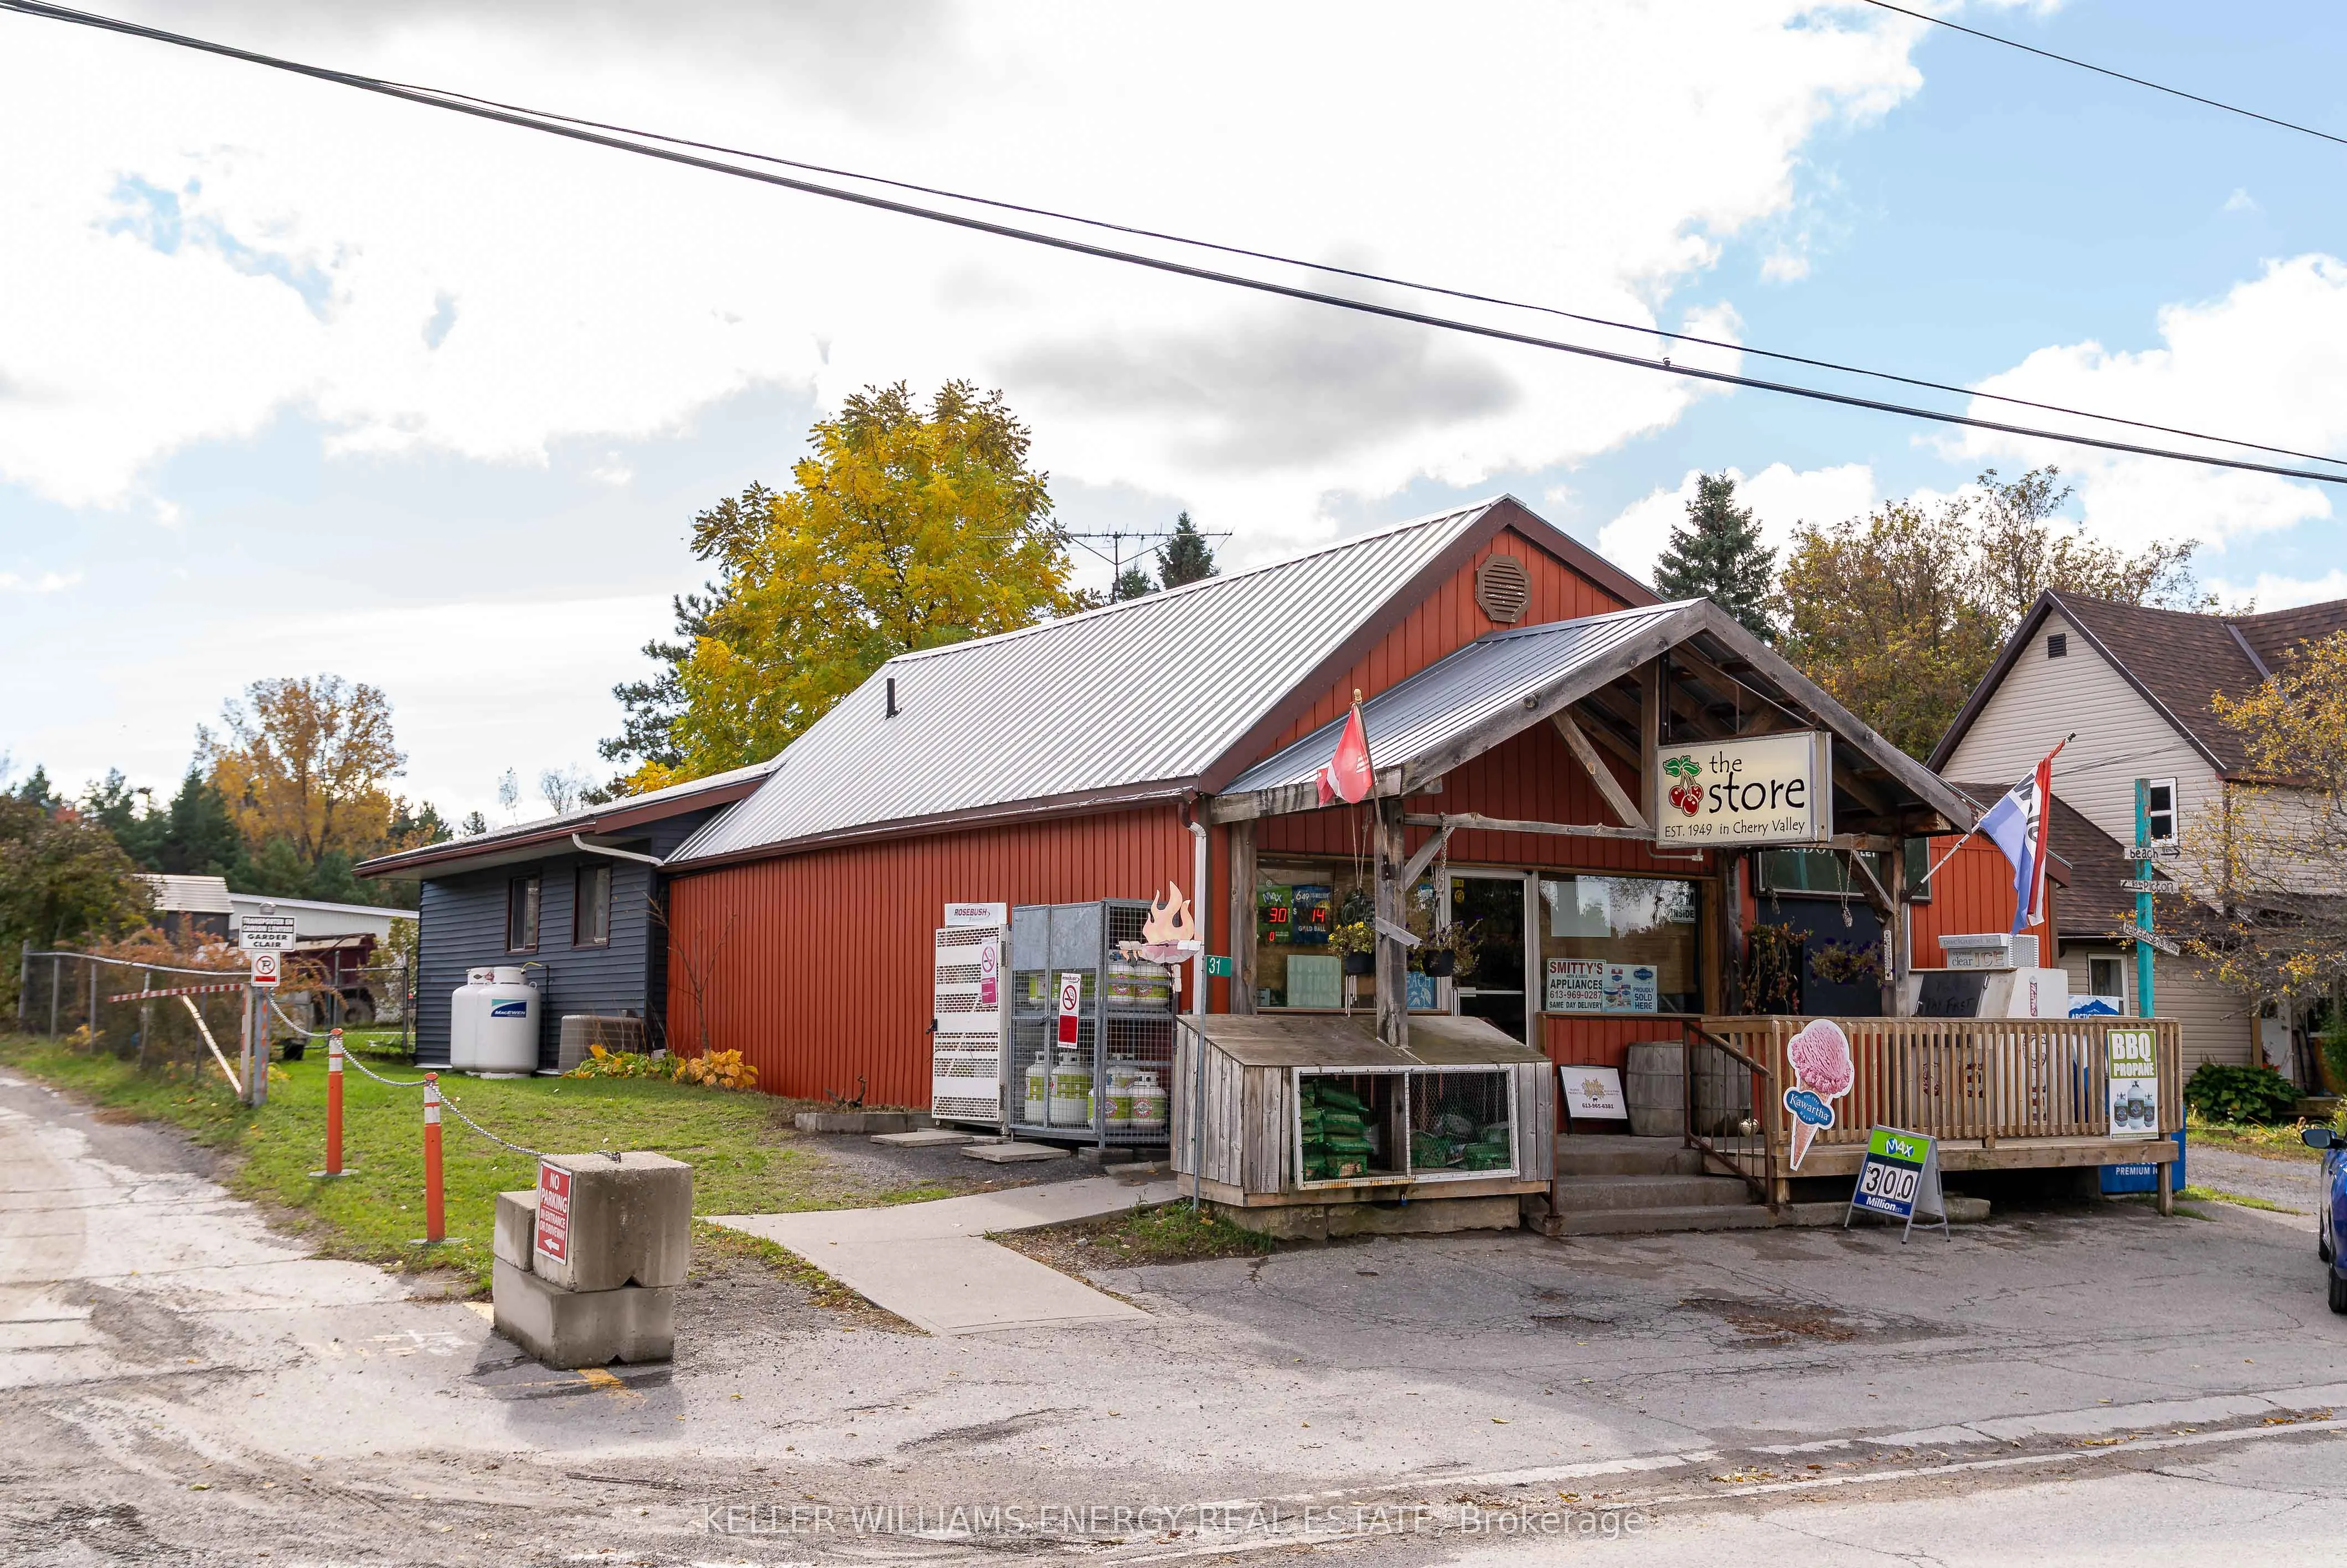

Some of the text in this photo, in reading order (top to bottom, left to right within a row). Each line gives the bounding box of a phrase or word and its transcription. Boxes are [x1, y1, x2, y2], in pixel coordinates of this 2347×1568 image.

[1709, 751, 1742, 773] the
[1709, 771, 1805, 813] store
[1665, 817, 1805, 837] EST. 1949 in Cherry Valley
[2130, 848, 2158, 859] beach
[2143, 881, 2174, 892] Picton
[1268, 907, 1287, 922] 30
[1312, 909, 1325, 922] 14
[1209, 957, 1220, 974] 31
[1952, 951, 2004, 967] clear ICE
[1550, 962, 1603, 974] SMITTY'S
[1550, 979, 1603, 990] APPLIANCES
[1550, 991, 1602, 999] 613-969-0287
[2112, 1033, 2152, 1062] BBQ
[2113, 1062, 2154, 1077] PROPANE
[1789, 1093, 1828, 1121] Kawartha
[1885, 1137, 1913, 1158] MAX
[2116, 1167, 2150, 1175] PREMIUM
[550, 1172, 560, 1190] NO
[541, 1187, 568, 1214] PARKING
[1866, 1196, 1896, 1211] Million
